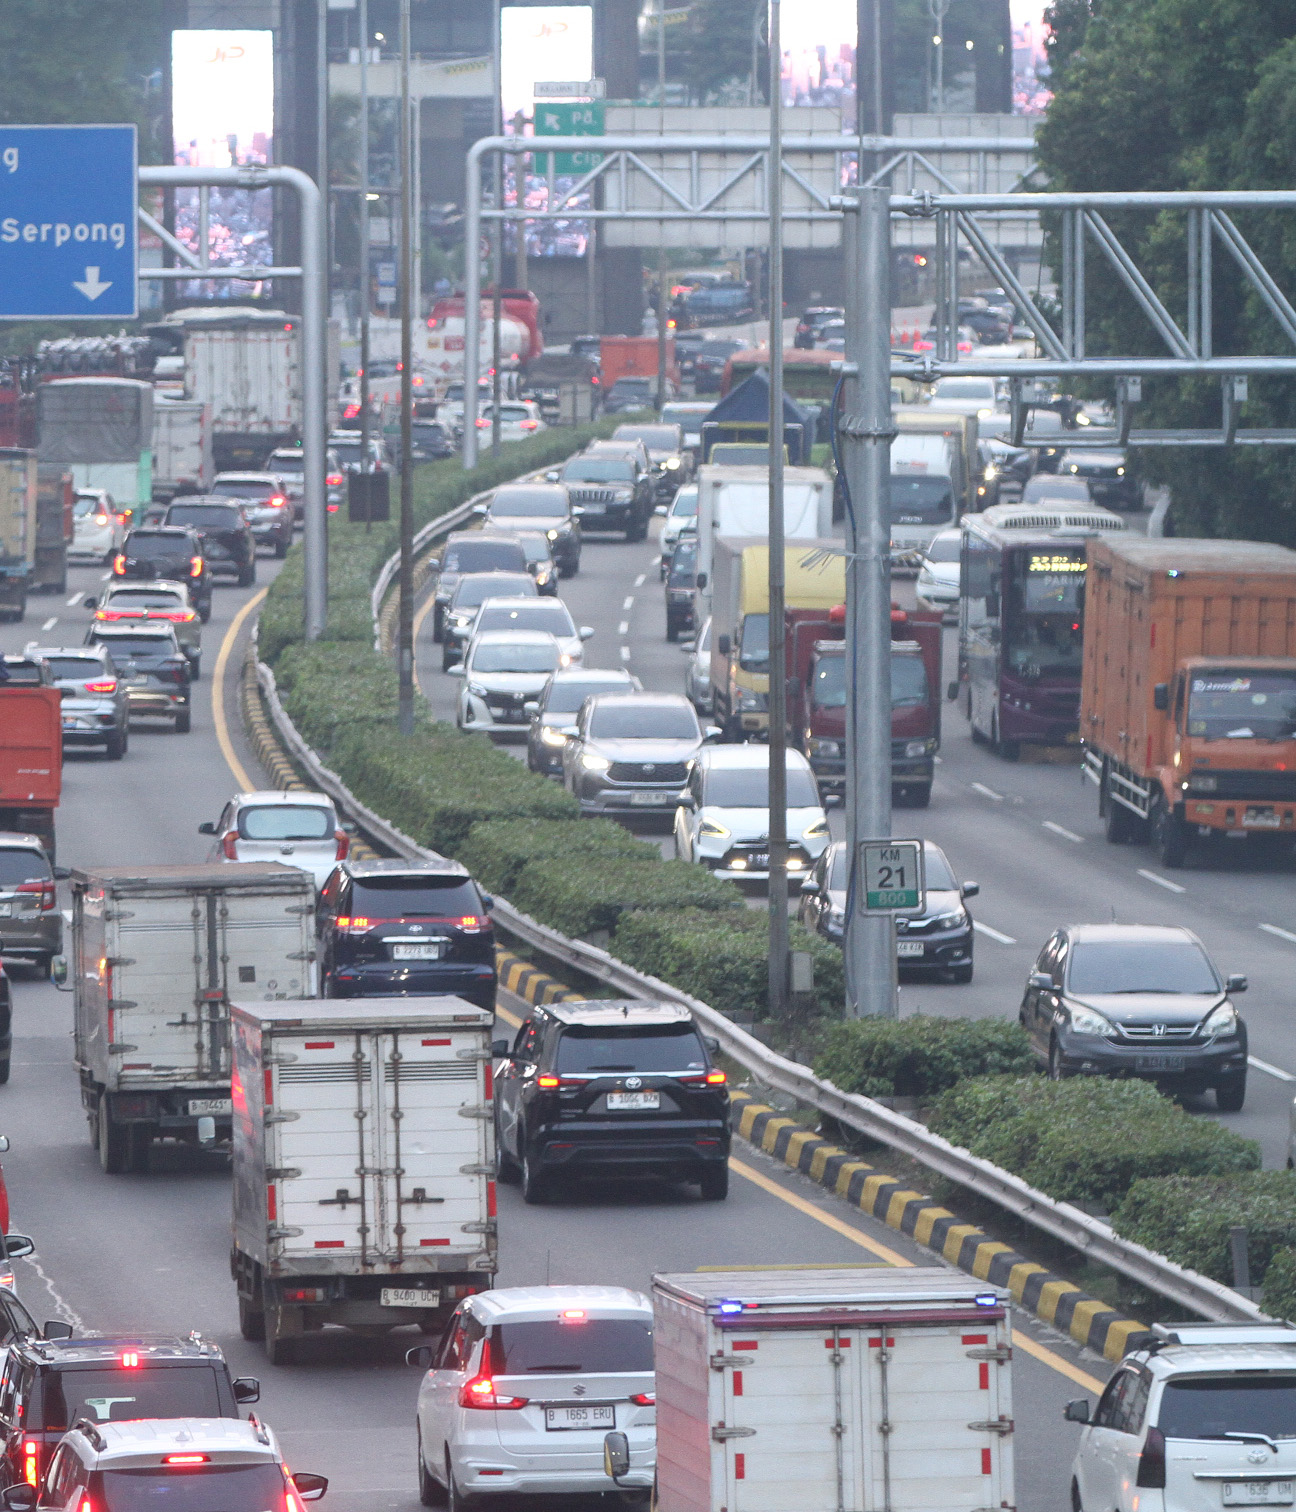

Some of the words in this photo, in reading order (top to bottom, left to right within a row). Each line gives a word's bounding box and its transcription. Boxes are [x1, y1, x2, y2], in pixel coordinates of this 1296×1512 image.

[880, 849, 900, 861] KM
[878, 865, 906, 889] 21
[878, 891, 906, 905] 800
[548, 1410, 555, 1421] B
[566, 1409, 588, 1420] 1665
[593, 1408, 611, 1419] ERU
[1224, 1483, 1232, 1497] D
